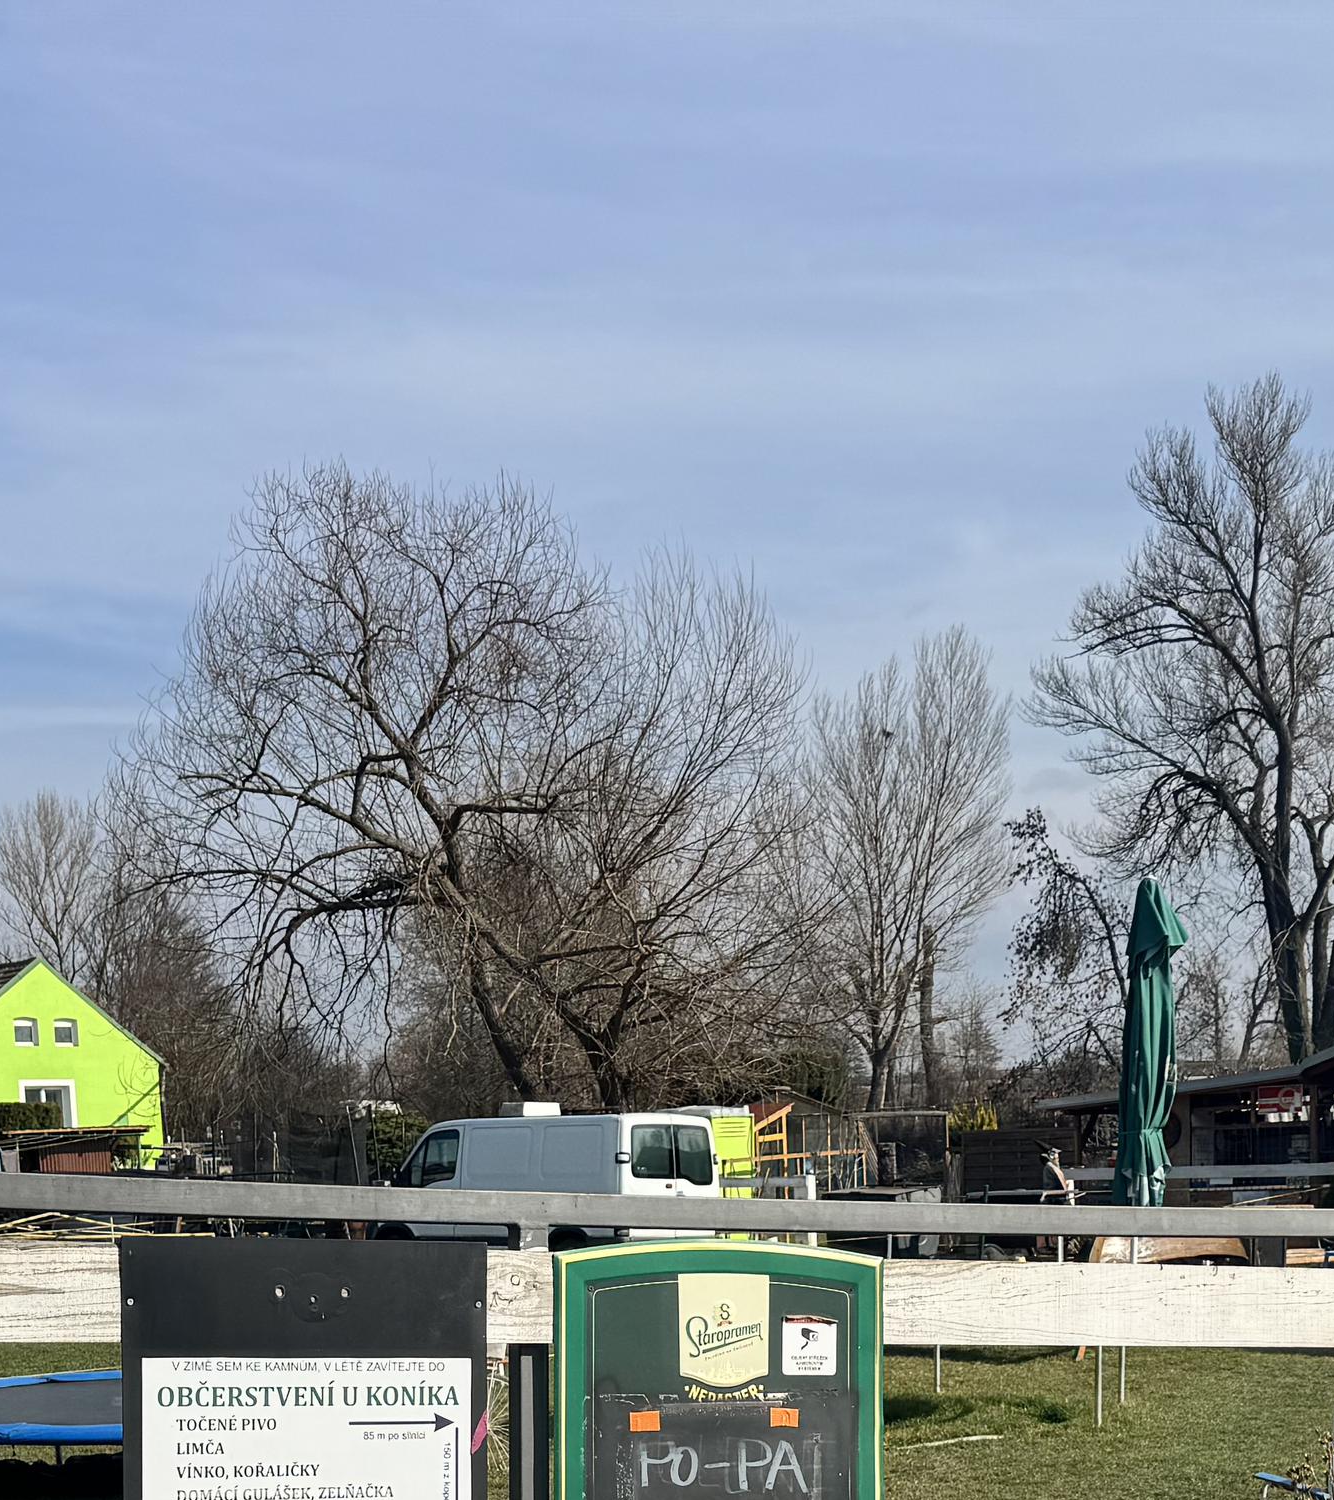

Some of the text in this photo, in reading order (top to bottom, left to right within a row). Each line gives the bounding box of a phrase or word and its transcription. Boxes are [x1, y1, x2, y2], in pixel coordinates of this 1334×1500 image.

[720, 1303, 730, 1320] S
[685, 1316, 764, 1358] Staropramen
[171, 1361, 180, 1371] V
[183, 1360, 212, 1371] ZIMĚ
[216, 1361, 242, 1371] SEM
[245, 1361, 261, 1371] KE
[323, 1361, 331, 1371] V
[335, 1360, 362, 1371] LÉTĚ
[366, 1359, 426, 1371] ZAVÍTEJTE
[428, 1361, 445, 1371] DO
[157, 1380, 459, 1407] OBČERSTVENÍ U KONÍKA
[176, 1415, 277, 1431] TOČENÉ PIVO
[363, 1431, 375, 1440] 85
[388, 1433, 399, 1441] po
[177, 1439, 225, 1455] LIMČA
[177, 1462, 320, 1480] VÍNKO, KOŘALIČKY
[243, 1485, 314, 1500] GULÁŠEK,
[318, 1484, 394, 1499] ZELŇAČKA
